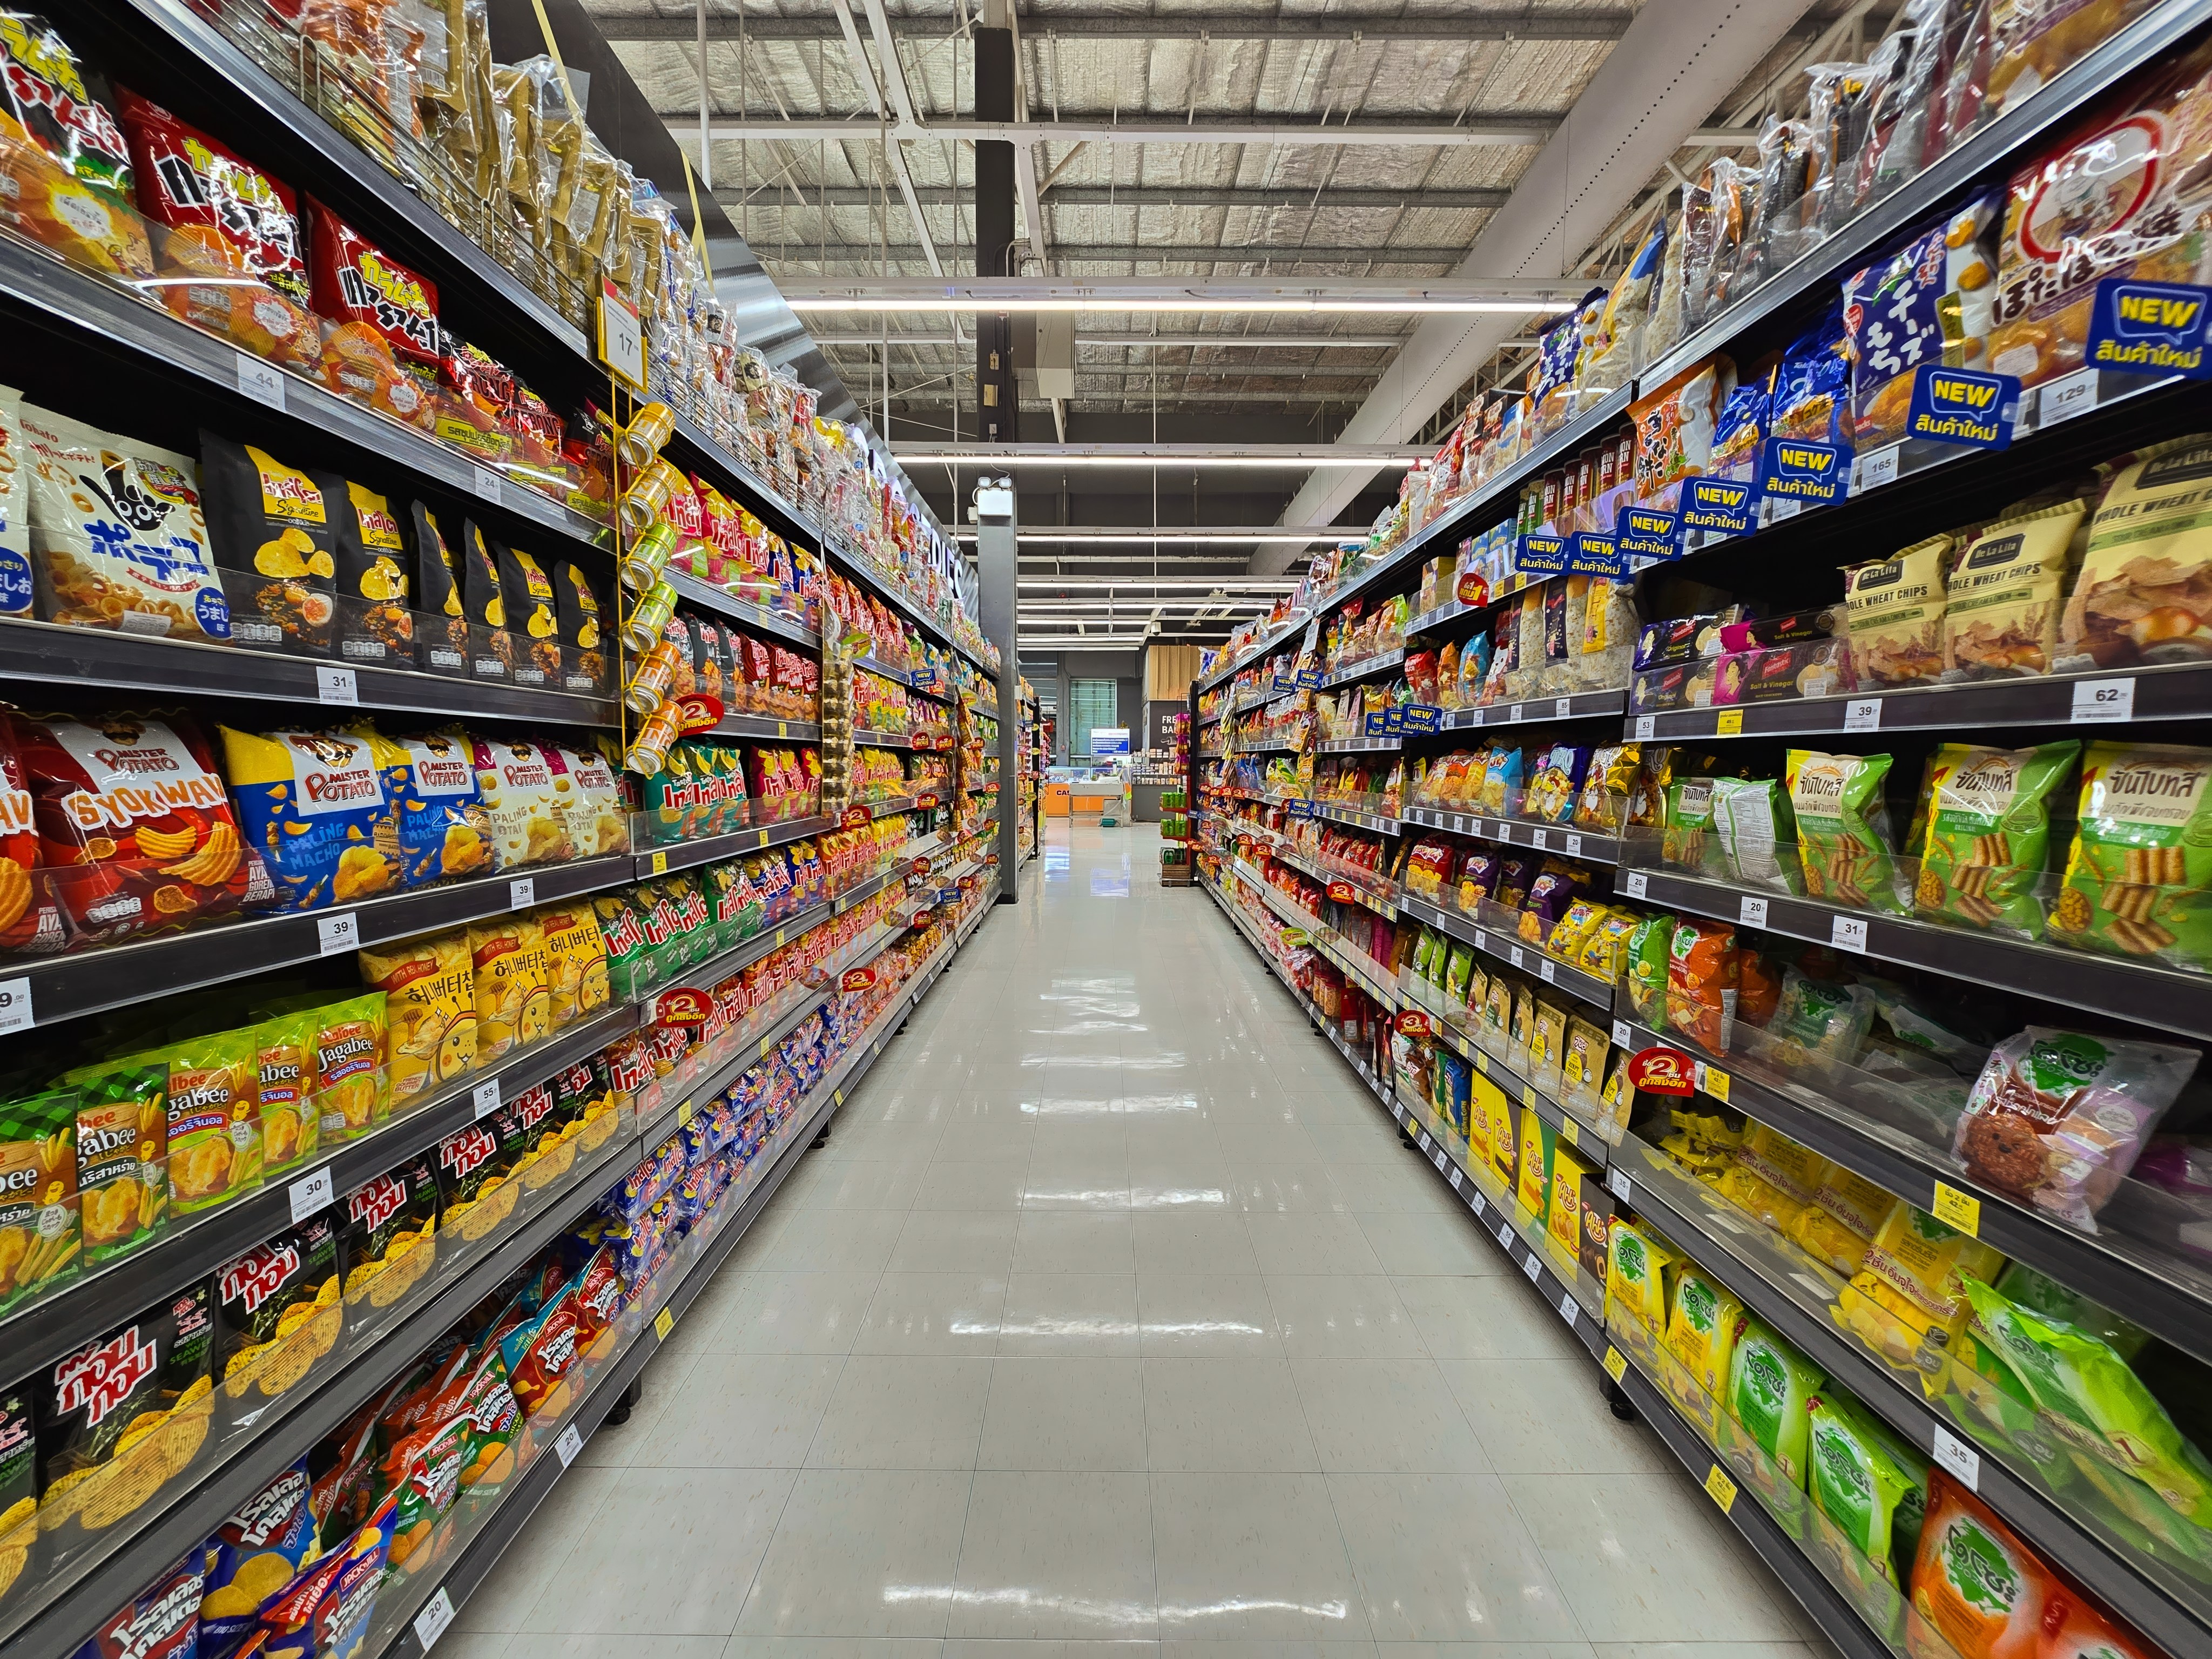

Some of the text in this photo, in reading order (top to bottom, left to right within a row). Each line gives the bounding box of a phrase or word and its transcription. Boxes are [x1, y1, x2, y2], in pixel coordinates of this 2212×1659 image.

[2120, 296, 2200, 328] NEW
[619, 332, 632, 356] 17
[2095, 339, 2203, 369] สินค้าใหม่
[255, 371, 274, 388] 44
[1934, 380, 1996, 407] NEW
[2055, 383, 2086, 404] 129
[1915, 414, 1998, 442] สินค้าใหม่
[1782, 449, 1832, 471] NEW
[1872, 458, 1891, 473] 165
[484, 477, 495, 488] 24
[1767, 476, 1835, 498] สินค้าใหม่
[1697, 485, 1745, 507] NEW
[1631, 517, 1672, 535] NEW
[1683, 511, 1746, 531] สินค้าใหม่
[1529, 540, 1561, 553] NEW
[1582, 540, 1614, 556] NEW
[1620, 538, 1674, 557] สินค้าใหม่
[1520, 557, 1563, 570] สินค้าใหม่
[1571, 560, 1621, 575] สินค้าใหม่
[1973, 570, 2007, 586] WHEAT
[2008, 563, 2041, 578] CHIPS
[1865, 592, 1894, 606] WHEAT
[1897, 585, 1928, 599] CHIPS
[332, 676, 347, 688] 31
[1769, 679, 1793, 688] Vinegar
[2095, 689, 2119, 702] 62
[1410, 709, 1433, 719] NEW
[1858, 706, 1872, 716] 39
[94, 748, 179, 773] POTATO
[114, 748, 168, 760] MISTER
[418, 760, 468, 786] POTATO
[430, 761, 464, 772] MISTER
[515, 764, 544, 773] MISTER
[328, 769, 371, 783] MISTER
[504, 765, 549, 787] POTATO
[304, 771, 376, 804] POTATO
[492, 806, 527, 824] PALING
[851, 811, 861, 820] 2
[286, 823, 346, 852] PALING
[290, 842, 341, 869] MACHO
[519, 885, 528, 894] 39
[1750, 902, 1762, 912] 20
[333, 921, 349, 933] 39
[1845, 923, 1858, 935] 31
[675, 999, 691, 1011] 2
[666, 1013, 705, 1022] ถูกลงอีก
[1619, 1027, 1627, 1035] 20
[319, 1038, 374, 1072] Jagabee
[1648, 1060, 1672, 1077] 2
[1638, 1077, 1687, 1089] ถูกลงอีก
[483, 1087, 494, 1100] 55
[305, 1180, 322, 1196] 30
[1619, 1178, 1626, 1188] 35
[1505, 1230, 1511, 1238] 55
[1531, 1261, 1537, 1270] 55
[1568, 1302, 1576, 1313] 55
[565, 1433, 575, 1446] 20
[1948, 1443, 1968, 1464] 35
[428, 1599, 442, 1616] 20
